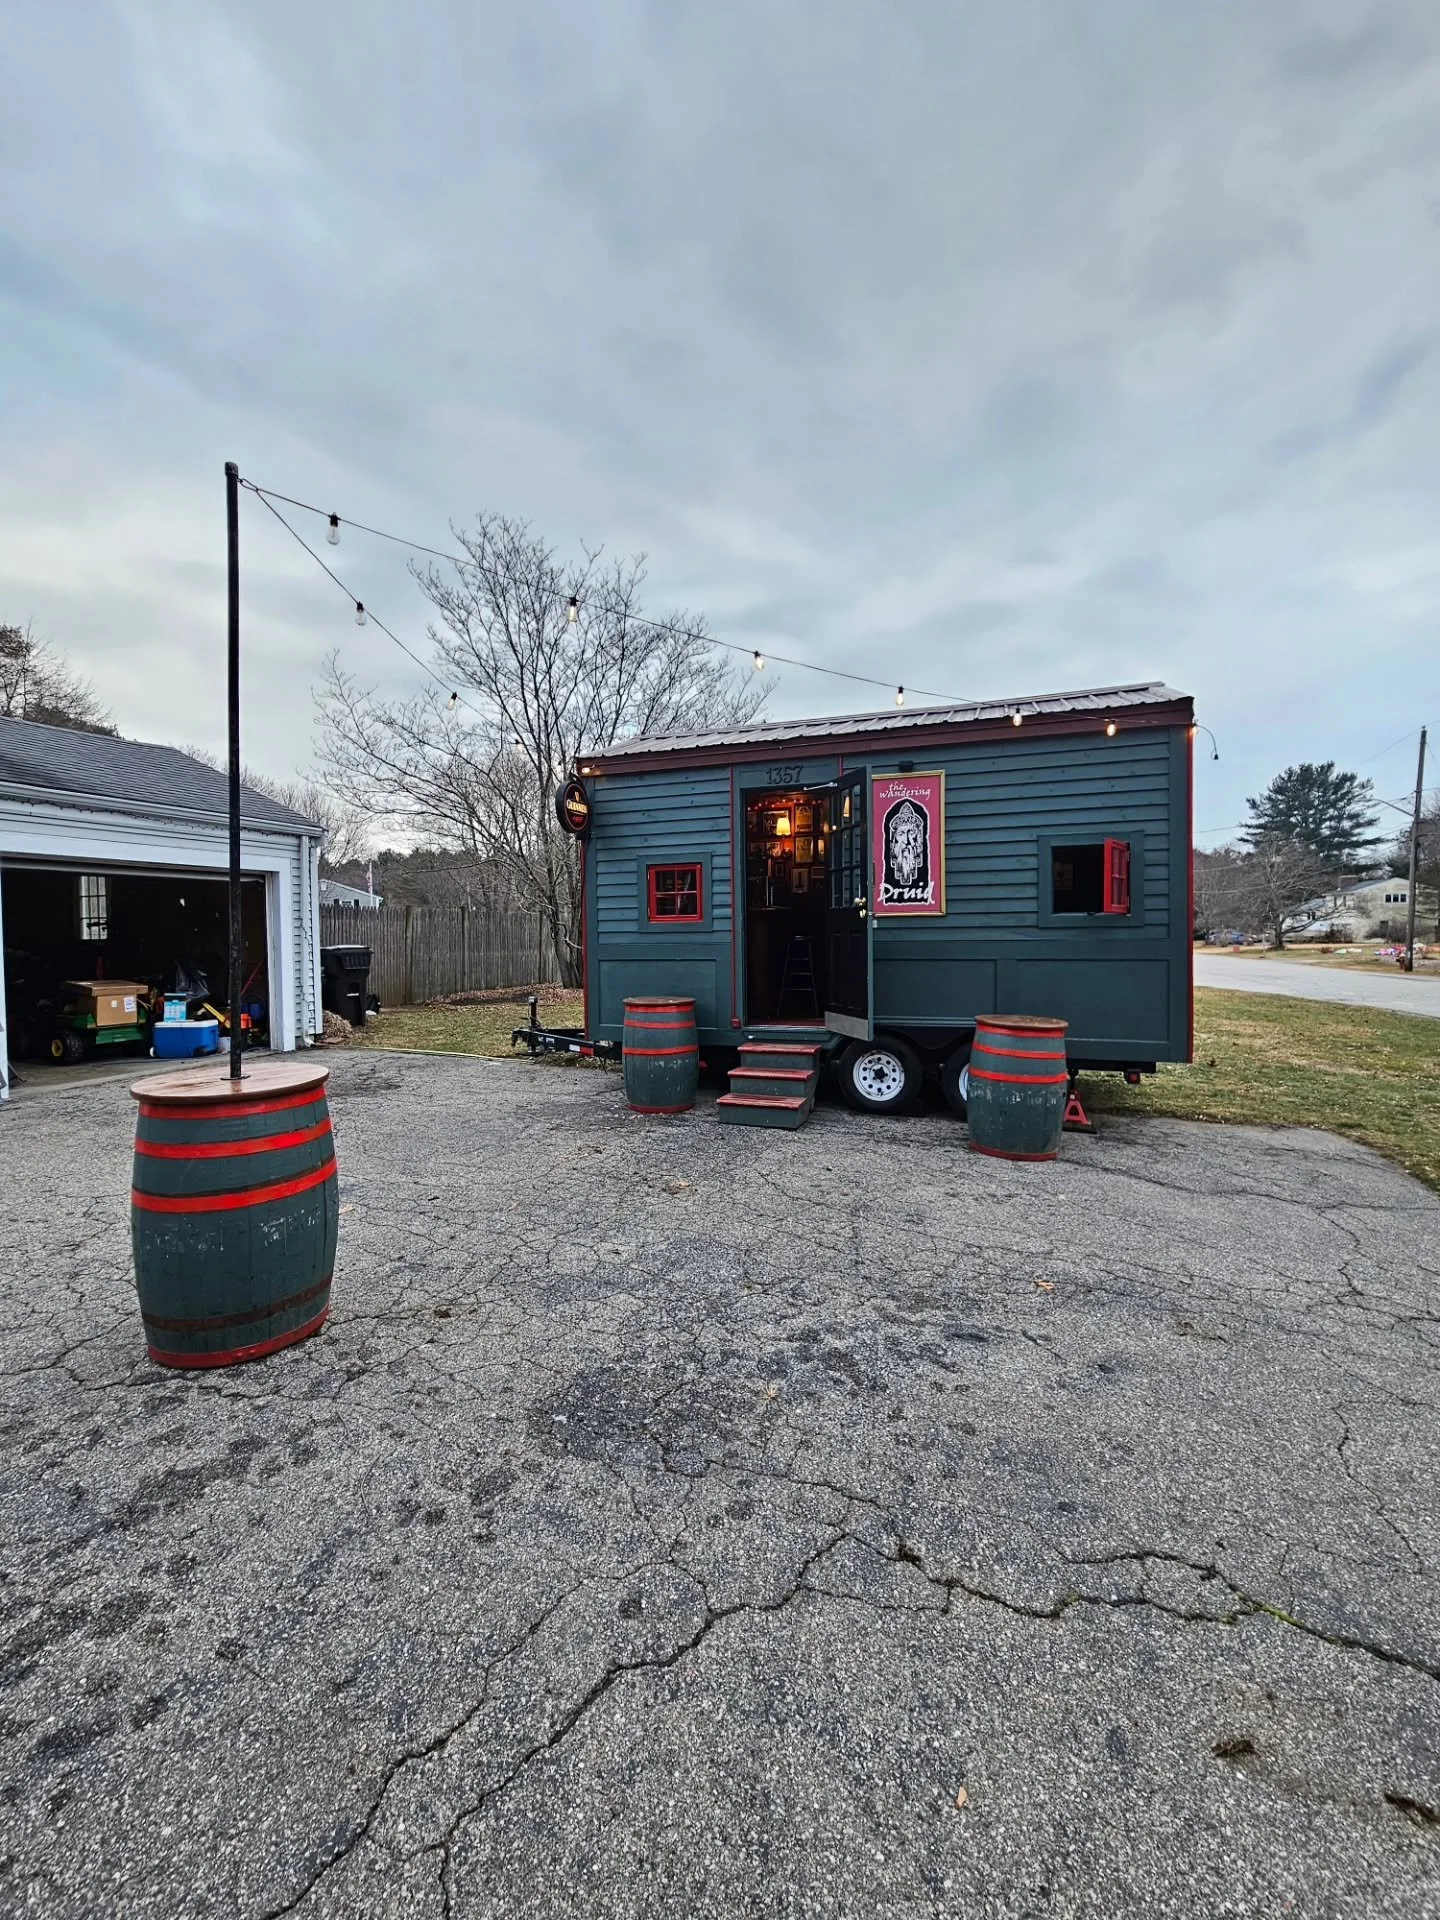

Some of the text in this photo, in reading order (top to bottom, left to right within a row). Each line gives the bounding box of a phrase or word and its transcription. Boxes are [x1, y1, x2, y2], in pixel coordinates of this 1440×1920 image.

[766, 765, 804, 785] 1357
[879, 787, 931, 800] wandering
[889, 781, 903, 791] the
[878, 881, 935, 905] Druid
